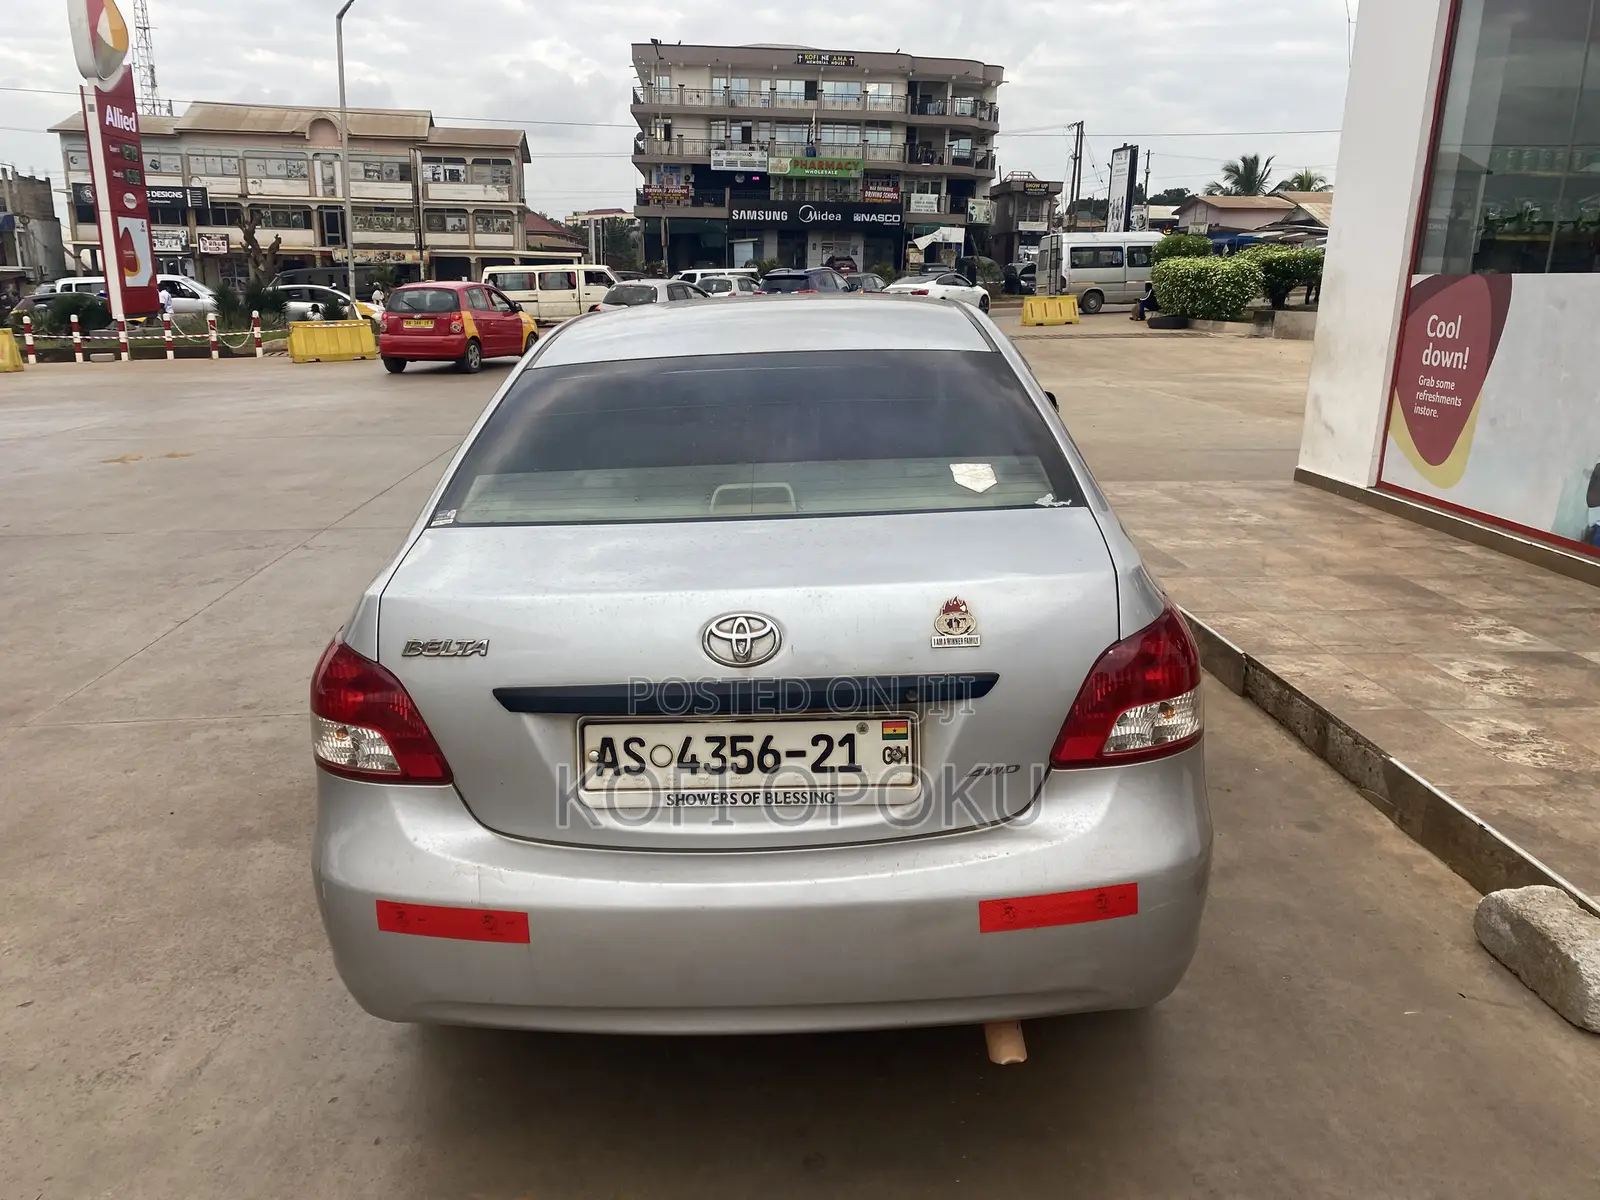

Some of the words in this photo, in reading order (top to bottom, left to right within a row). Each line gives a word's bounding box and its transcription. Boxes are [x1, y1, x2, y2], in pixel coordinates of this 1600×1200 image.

[105, 104, 137, 132] Allied
[793, 160, 860, 170] PHARMACY
[151, 190, 183, 198] DESIGNS
[732, 209, 788, 221] SAMSUNG
[800, 207, 842, 222] Midea
[861, 214, 900, 223] NASCO
[1427, 314, 1462, 339] Cool
[1422, 342, 1470, 370] down!
[1418, 375, 1435, 388] Grab
[1435, 381, 1456, 390] some
[1416, 389, 1462, 407] refreshments
[1413, 403, 1439, 418] instore.
[402, 639, 490, 656] BELTA
[597, 736, 647, 777] AS
[676, 733, 863, 776] 4356-21
[666, 792, 738, 806] SHOWERS
[741, 792, 760, 805] OF
[764, 791, 836, 805] BLESSING
